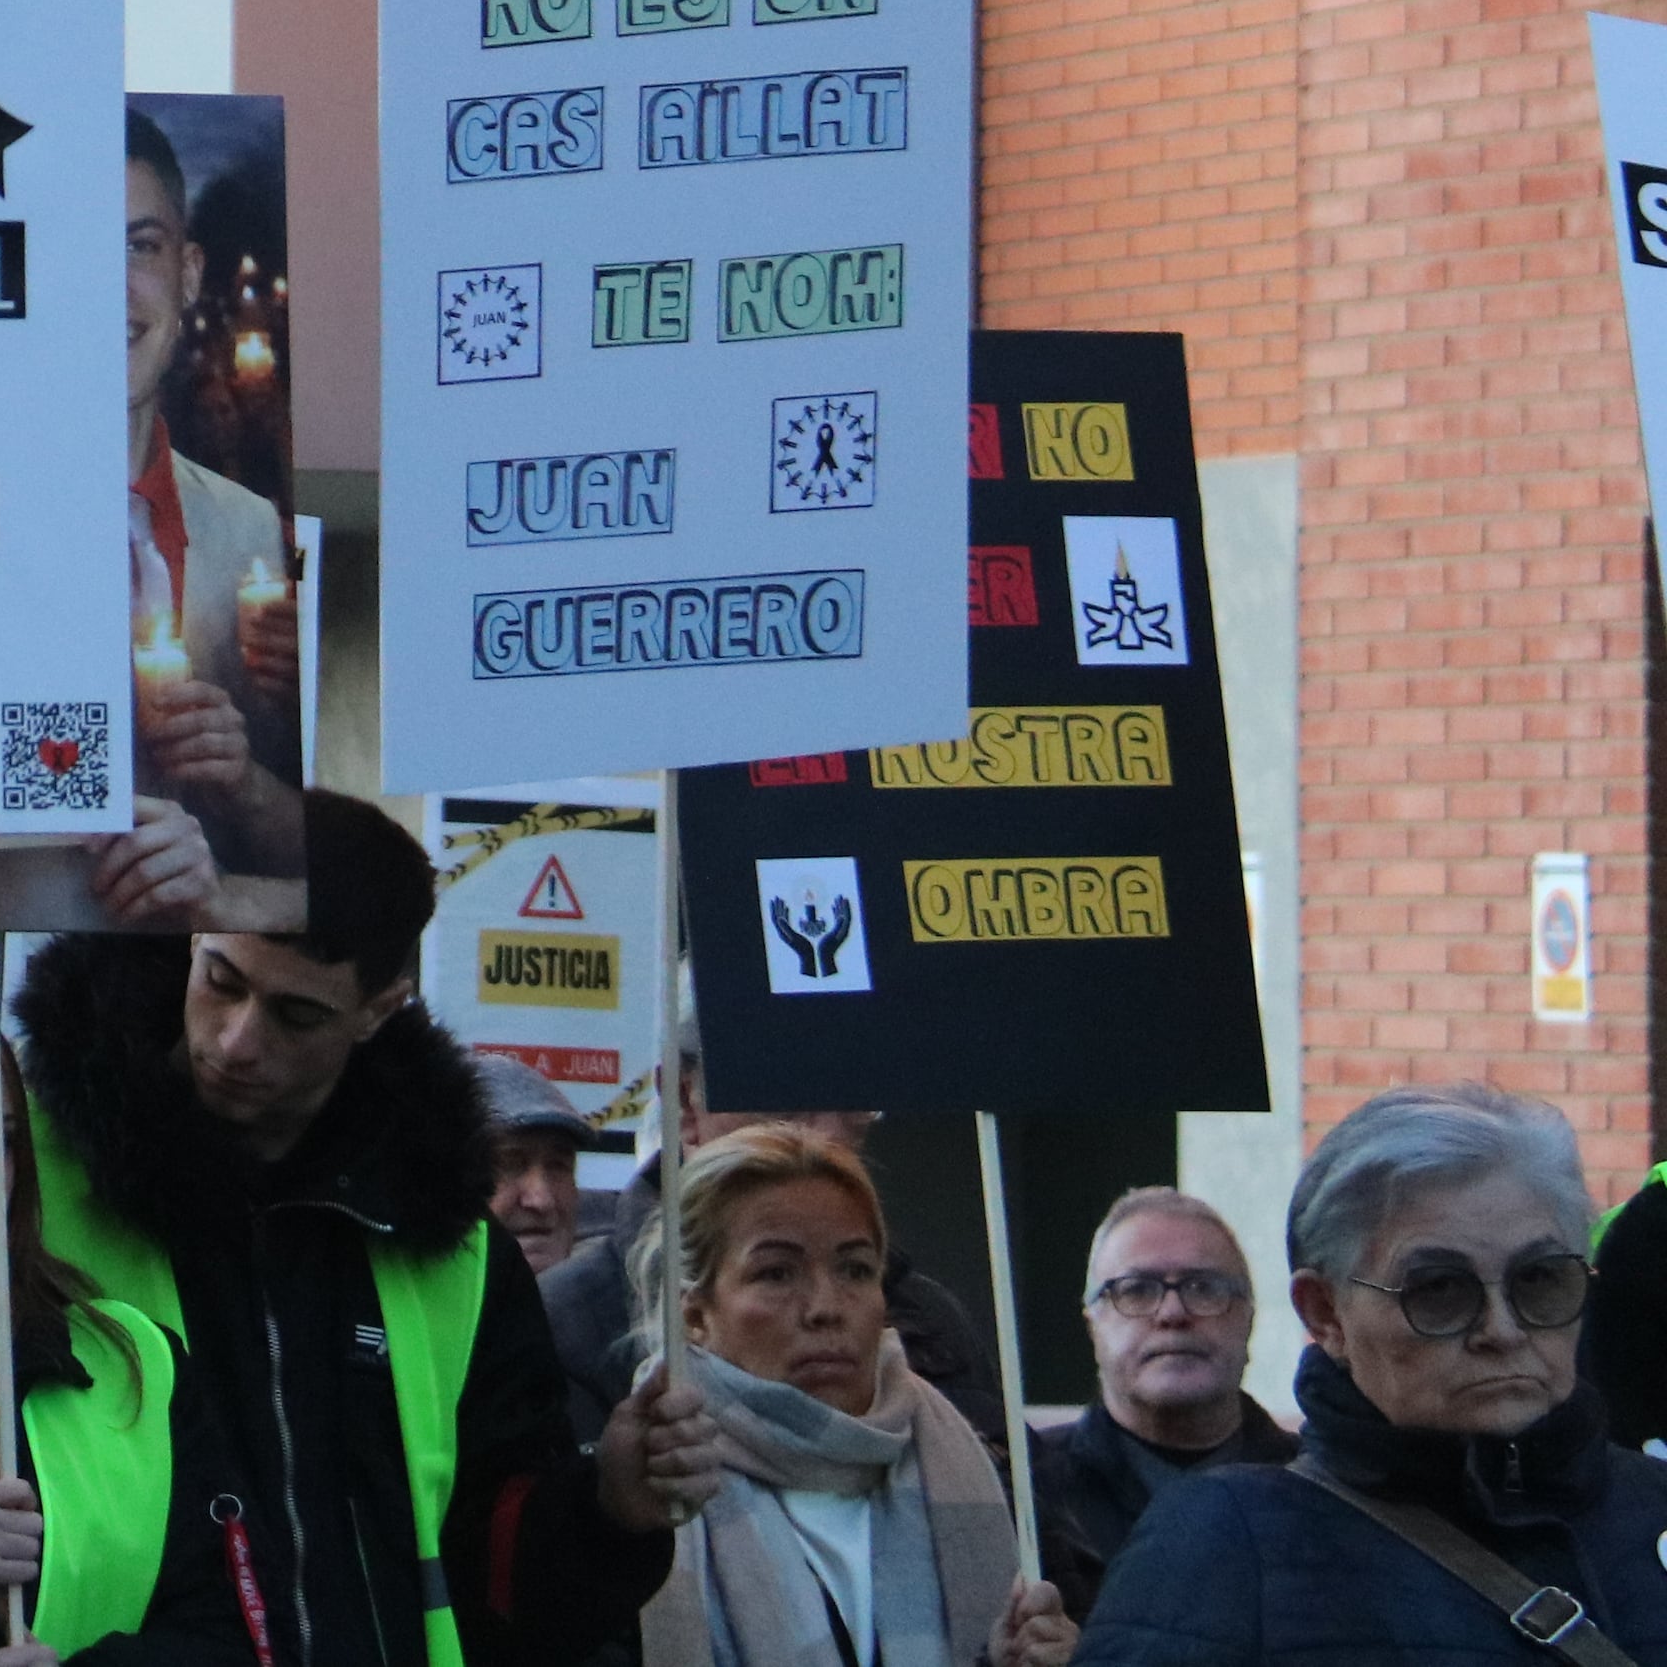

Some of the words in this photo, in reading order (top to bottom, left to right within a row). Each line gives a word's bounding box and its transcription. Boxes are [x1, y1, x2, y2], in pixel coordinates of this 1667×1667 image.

[450, 90, 599, 176] CAS
[472, 311, 507, 328] JUAN
[725, 251, 895, 336] NOM:
[1025, 405, 1124, 476] NO
[469, 453, 671, 535] JUAN
[475, 575, 855, 676] GUERRERO
[913, 863, 1166, 936] OMBRA
[484, 943, 611, 991] JUSTICIA
[563, 1054, 614, 1076] JUAN
